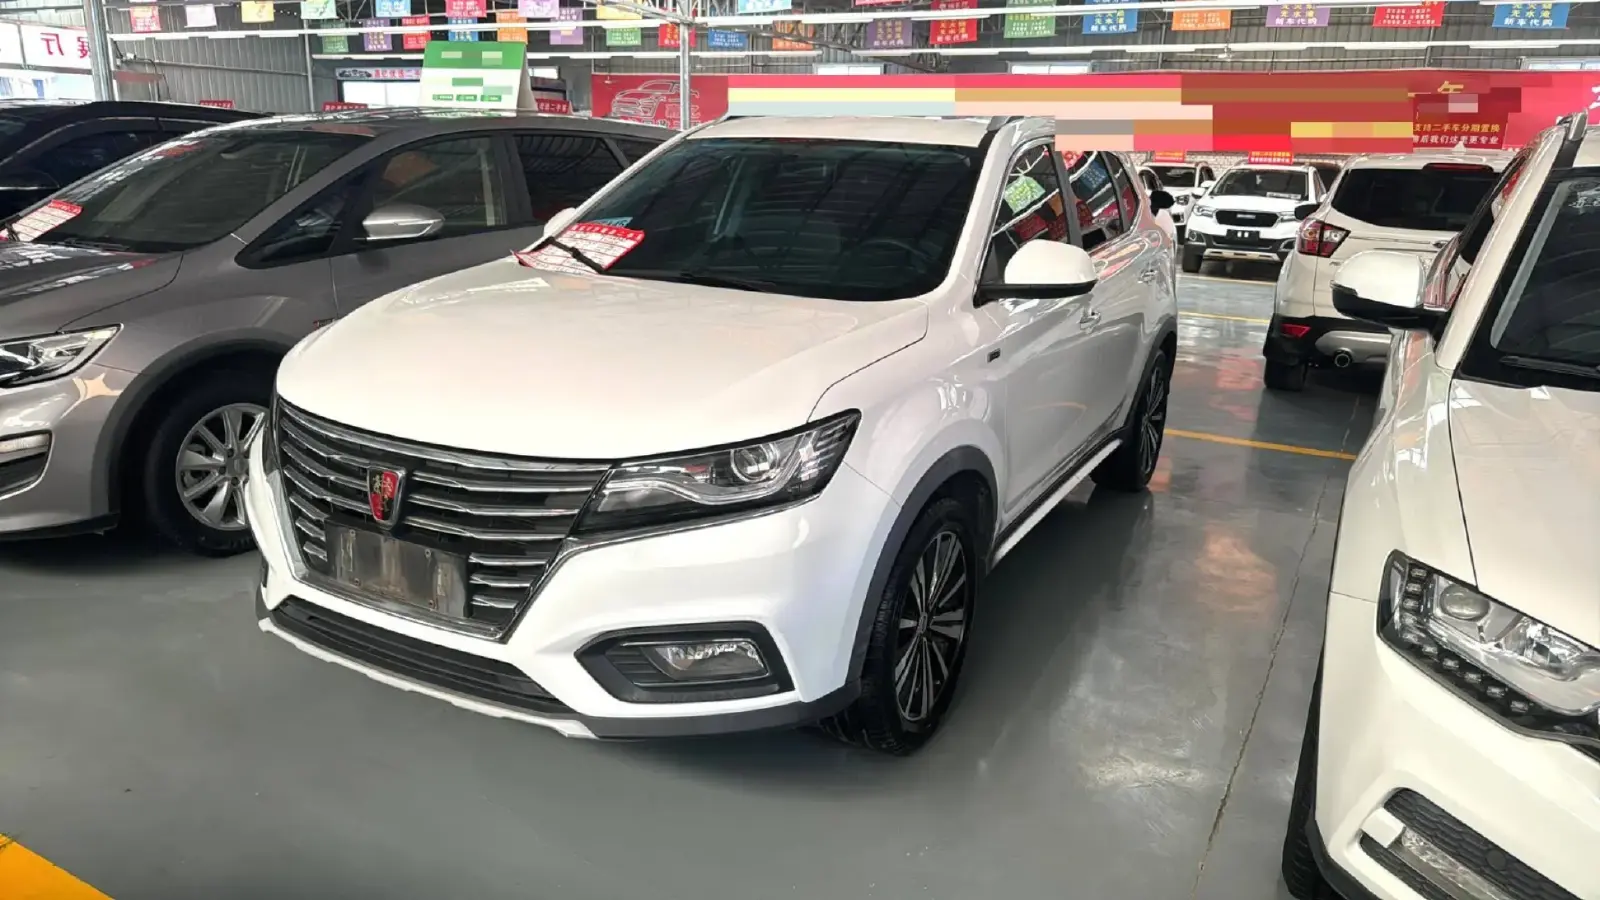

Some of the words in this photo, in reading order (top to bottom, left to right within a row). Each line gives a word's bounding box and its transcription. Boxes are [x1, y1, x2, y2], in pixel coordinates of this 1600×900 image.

[1503, 17, 1553, 27] 新车代购
[1090, 24, 1128, 32] 新车代购
